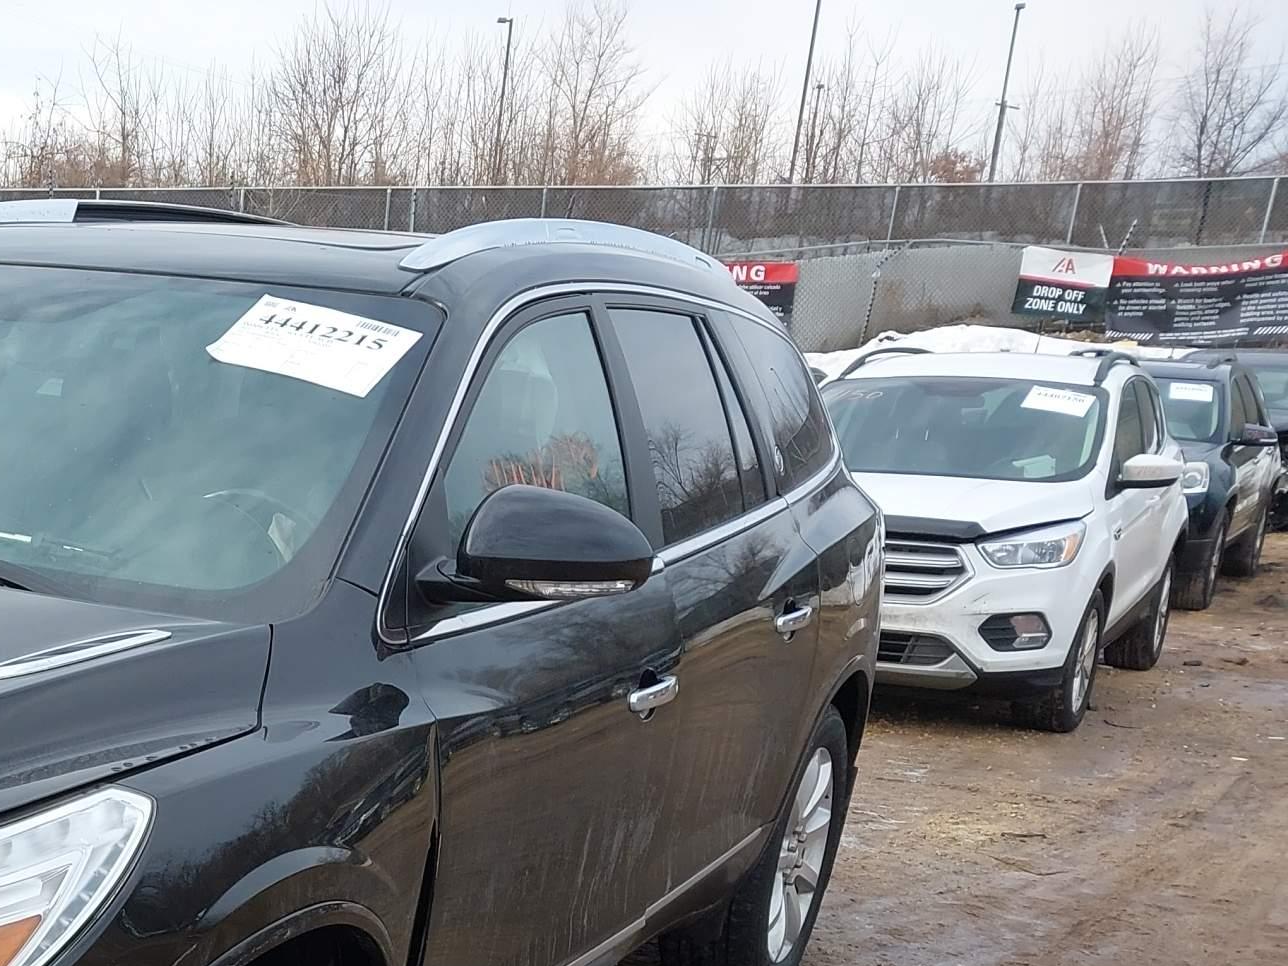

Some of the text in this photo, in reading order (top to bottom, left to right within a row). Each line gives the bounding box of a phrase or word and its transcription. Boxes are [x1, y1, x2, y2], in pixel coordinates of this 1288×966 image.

[1147, 255, 1284, 275] WARNING
[1033, 285, 1086, 302] DROP OFF
[1024, 297, 1086, 314] ZONE ONLY
[259, 313, 389, 351] 44412215
